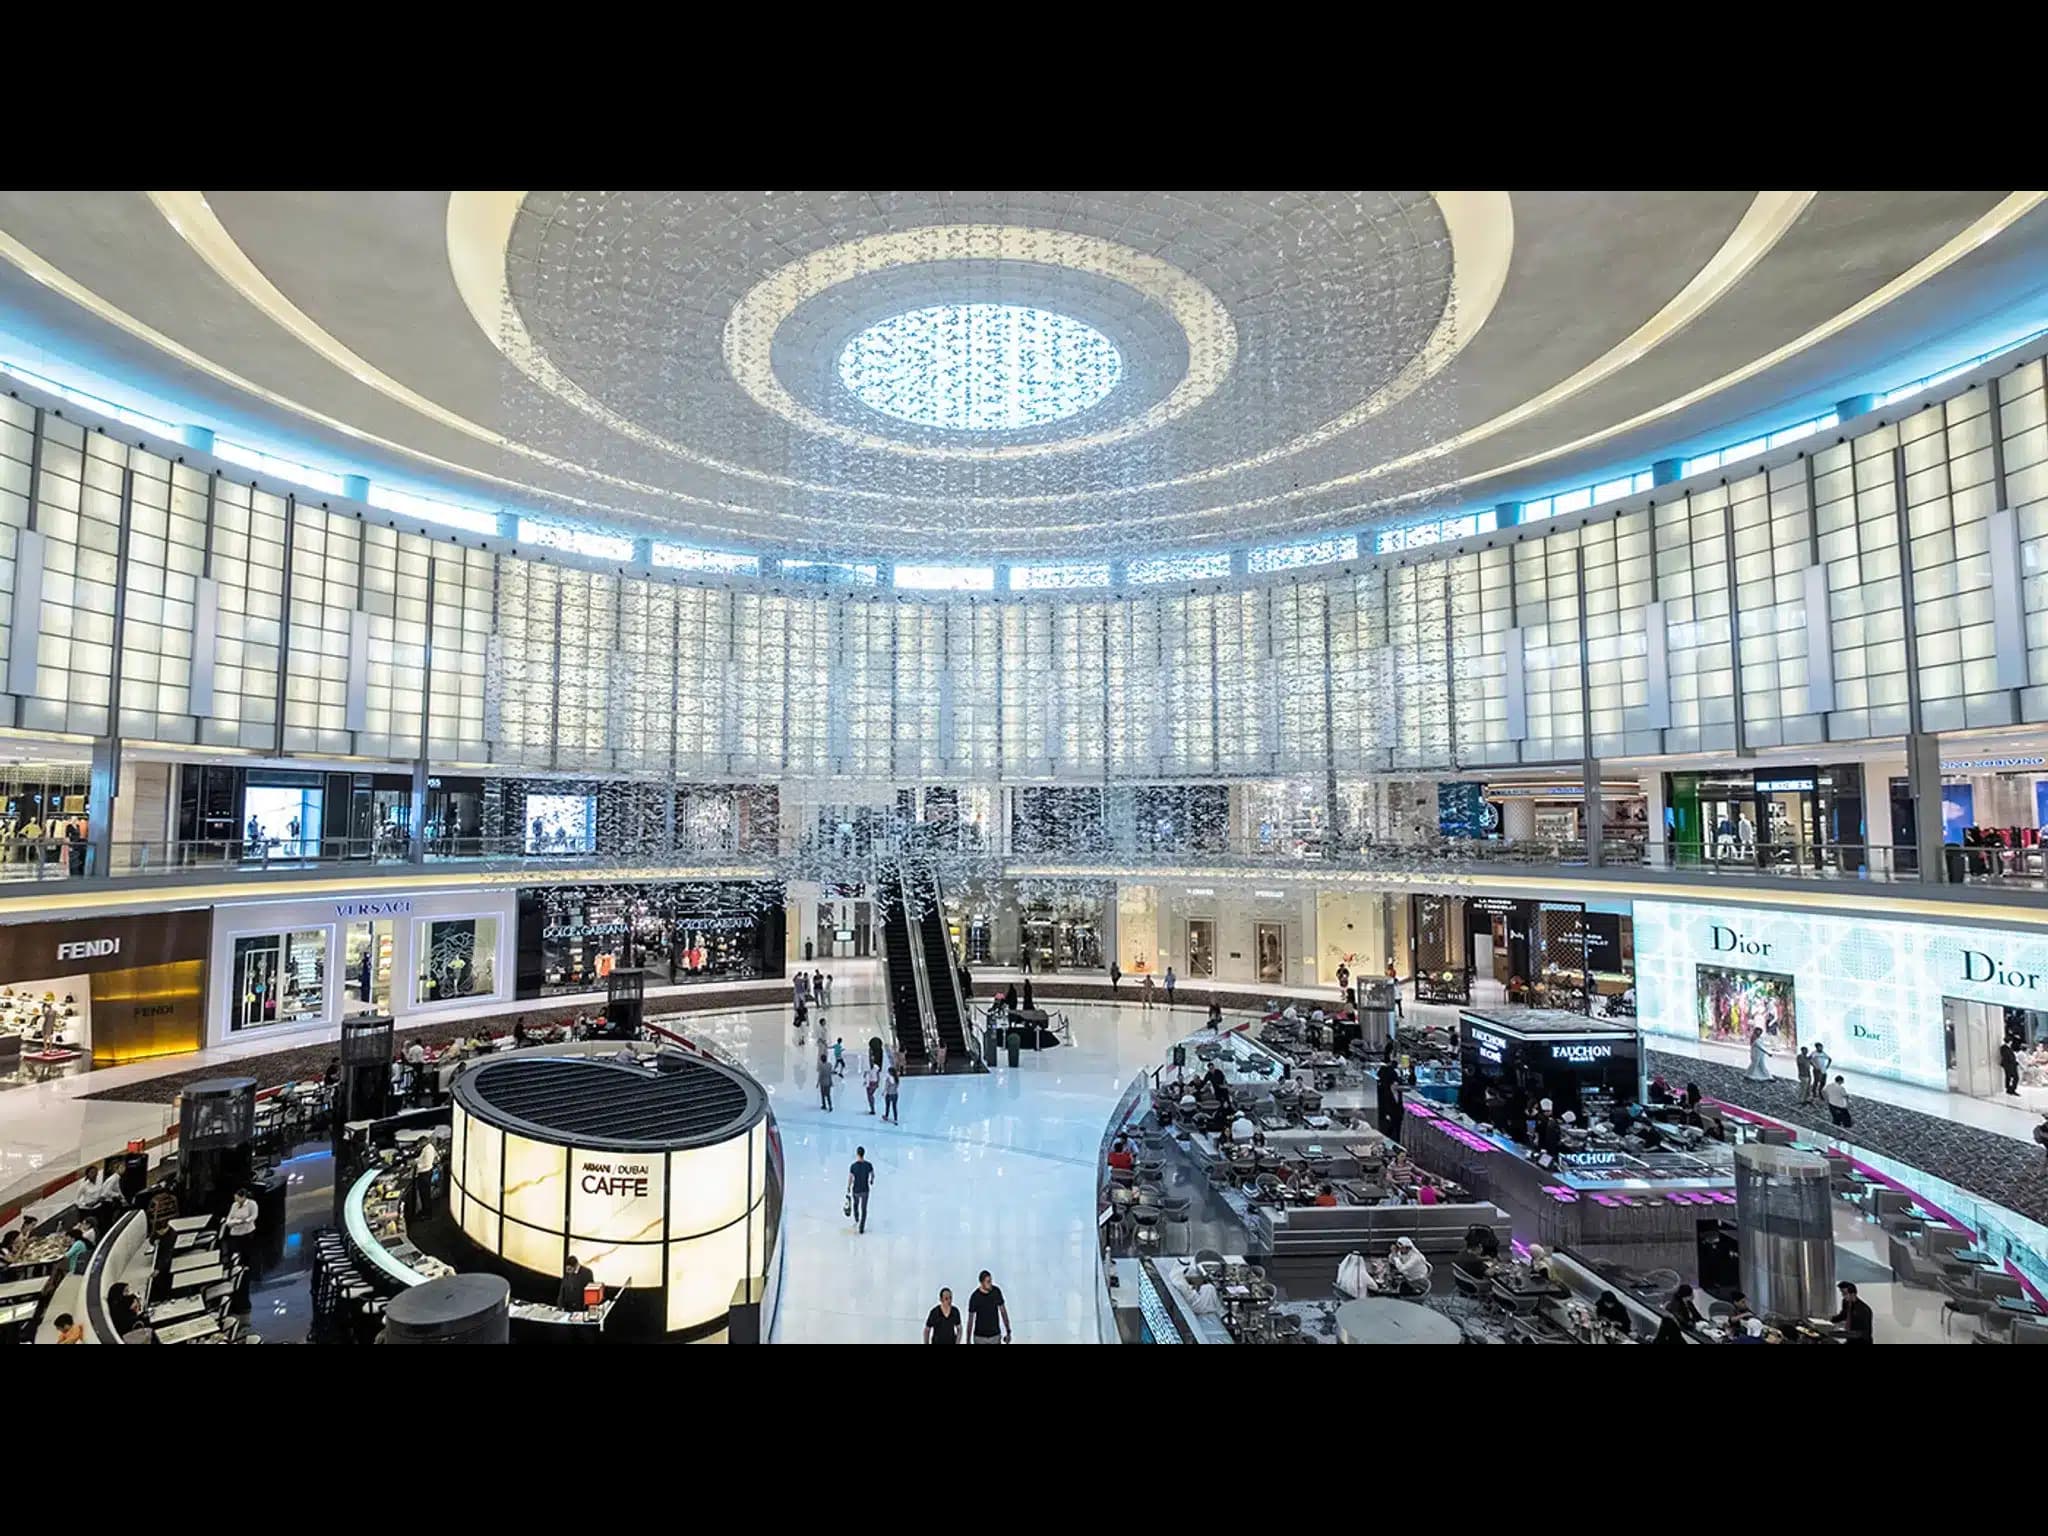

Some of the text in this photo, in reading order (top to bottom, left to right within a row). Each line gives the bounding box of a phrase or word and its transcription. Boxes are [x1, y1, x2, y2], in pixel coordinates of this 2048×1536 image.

[57, 937, 120, 960] FENDI
[1710, 925, 1772, 956] Dior
[1959, 949, 2040, 990] Dior
[134, 1004, 174, 1018] FENDI
[1853, 1024, 1880, 1040] Dior
[1552, 1045, 1611, 1058] FAUCHON
[618, 1165, 648, 1175] DUBAI
[581, 1175, 648, 1197] CAFFE
